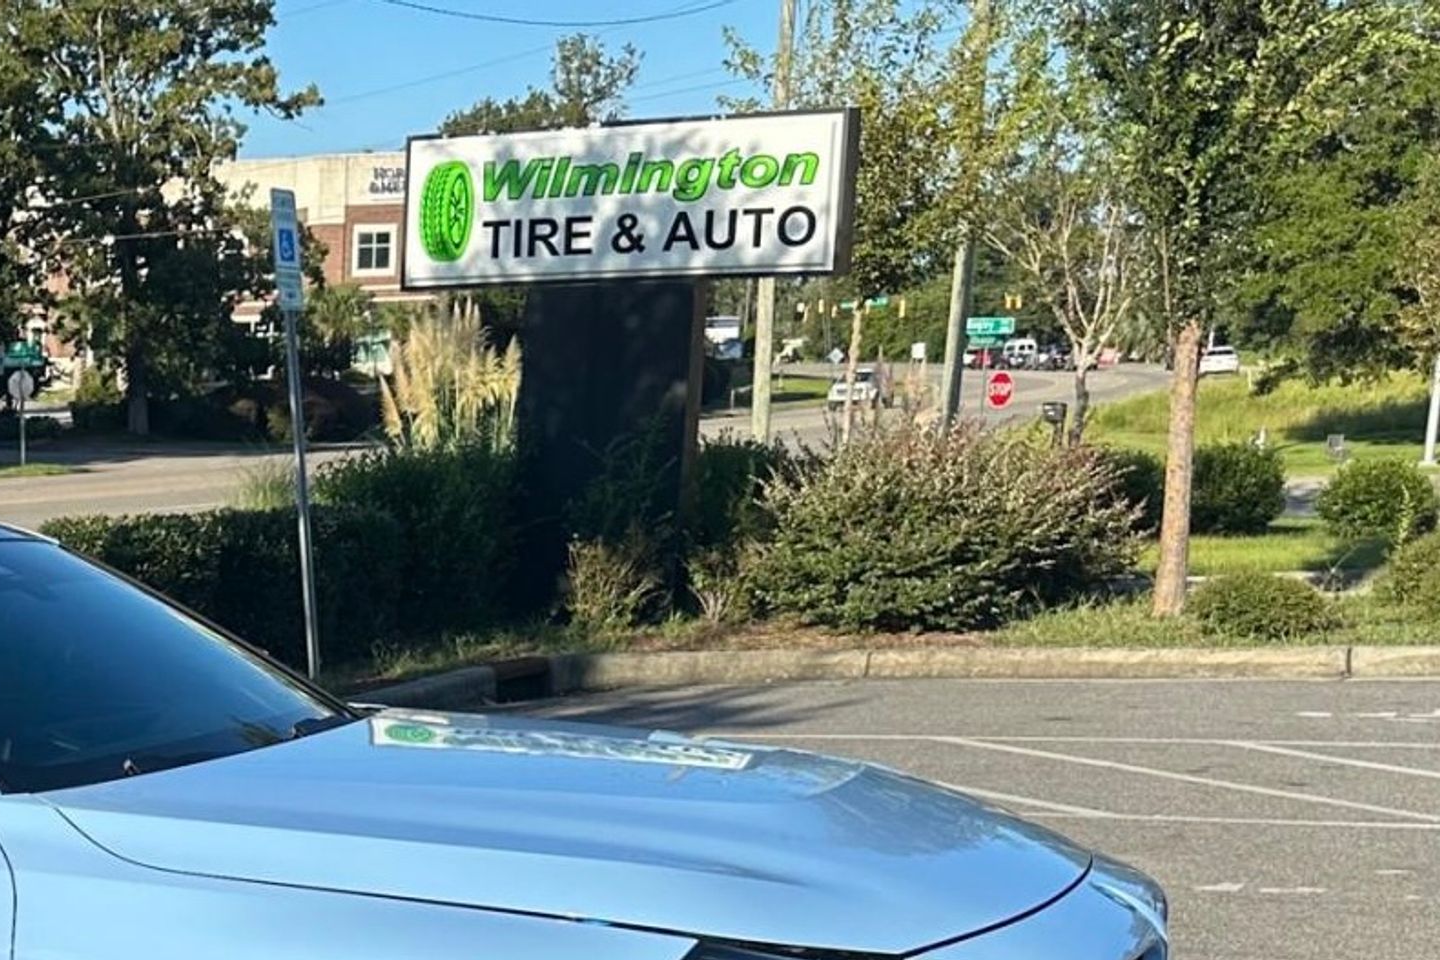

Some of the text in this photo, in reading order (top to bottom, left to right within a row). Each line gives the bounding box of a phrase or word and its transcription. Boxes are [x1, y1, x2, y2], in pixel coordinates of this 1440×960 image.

[482, 147, 821, 202] Wilmington
[482, 205, 818, 260] TIRE & AUTO
[989, 382, 1012, 397] STOP
